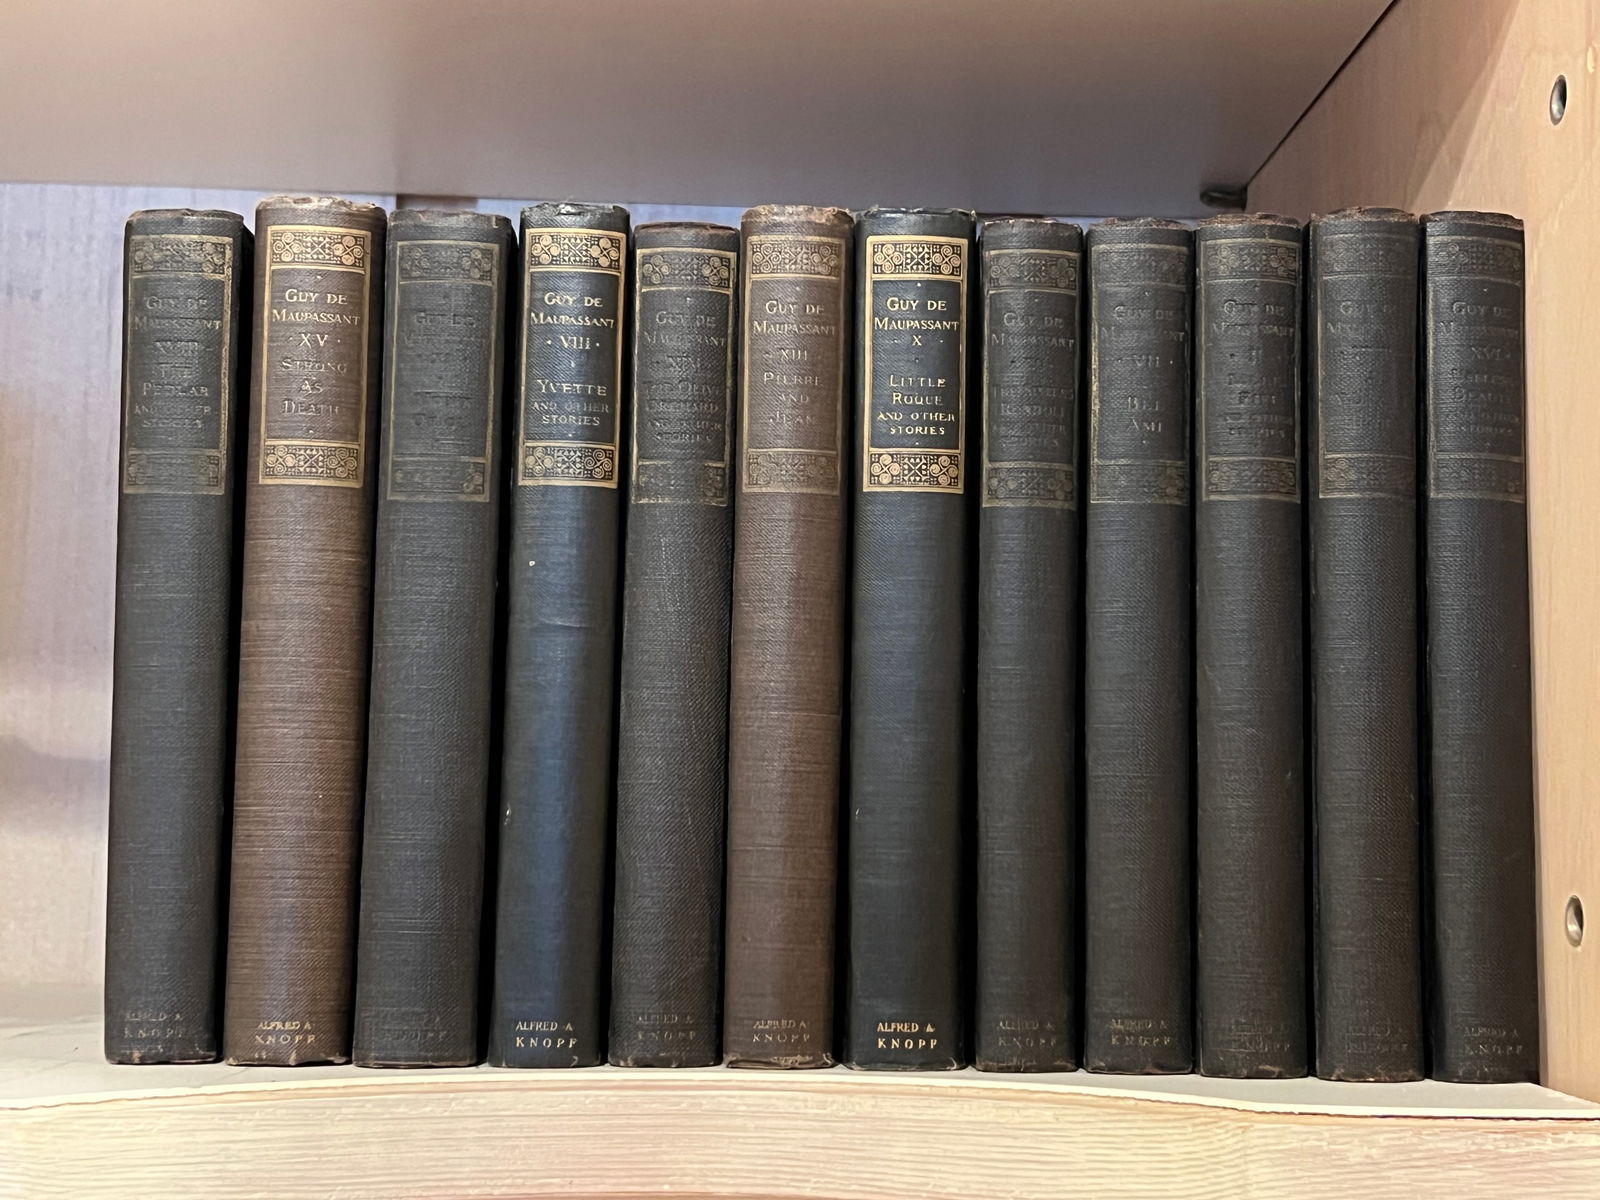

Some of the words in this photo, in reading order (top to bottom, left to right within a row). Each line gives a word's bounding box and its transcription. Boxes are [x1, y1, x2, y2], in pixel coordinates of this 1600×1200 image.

[285, 289, 319, 303] GUY
[327, 293, 348, 305] DE
[544, 292, 575, 306] GUY
[584, 296, 604, 308] DE
[887, 297, 919, 311] GUY
[927, 300, 947, 311] DE
[765, 301, 798, 314] GUY
[806, 304, 825, 315] DE
[1452, 301, 1488, 315] GUY
[272, 309, 361, 325] MAUPASSANT
[531, 312, 614, 328] MAUPASSANT
[753, 320, 836, 336] MAUPASSANT
[874, 318, 959, 331] MAUPASSANT
[281, 359, 347, 373] STRONG
[763, 372, 822, 386] PIERRE
[889, 374, 946, 388] LITTLE
[537, 379, 607, 396] YVETTE
[282, 400, 340, 416] DEATH
[533, 401, 557, 411] AND
[565, 402, 609, 413] OTHER
[542, 415, 600, 426] STORIES
[878, 411, 903, 422] AND
[910, 412, 955, 422] OTHER
[890, 426, 945, 436] STORIES
[258, 1020, 301, 1031] ALFRED
[515, 1021, 558, 1031] ALFRED
[564, 1022, 573, 1031] A
[753, 1020, 796, 1029] ALFRED
[877, 1022, 919, 1031] ALFRED
[926, 1023, 935, 1031] A
